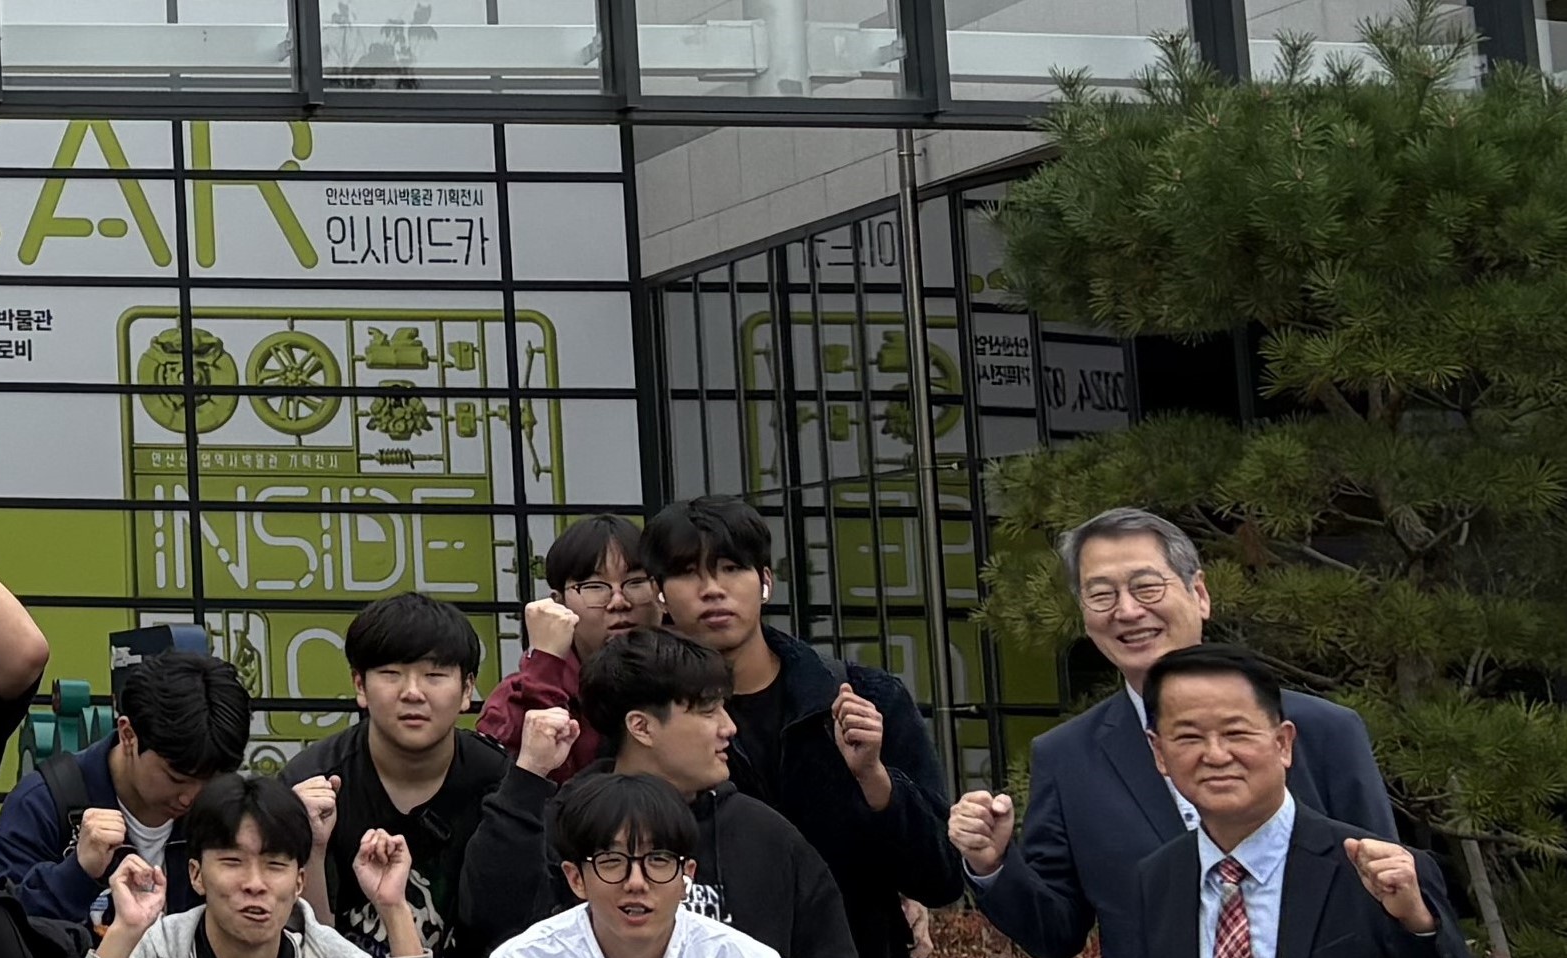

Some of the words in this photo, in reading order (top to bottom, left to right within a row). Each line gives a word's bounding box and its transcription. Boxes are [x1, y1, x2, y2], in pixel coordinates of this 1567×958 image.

[326, 187, 433, 206] 안산산업역사박물관
[436, 188, 484, 206] 기획전시
[326, 215, 490, 265] 인사이드카
[153, 484, 479, 593] INSIDE
